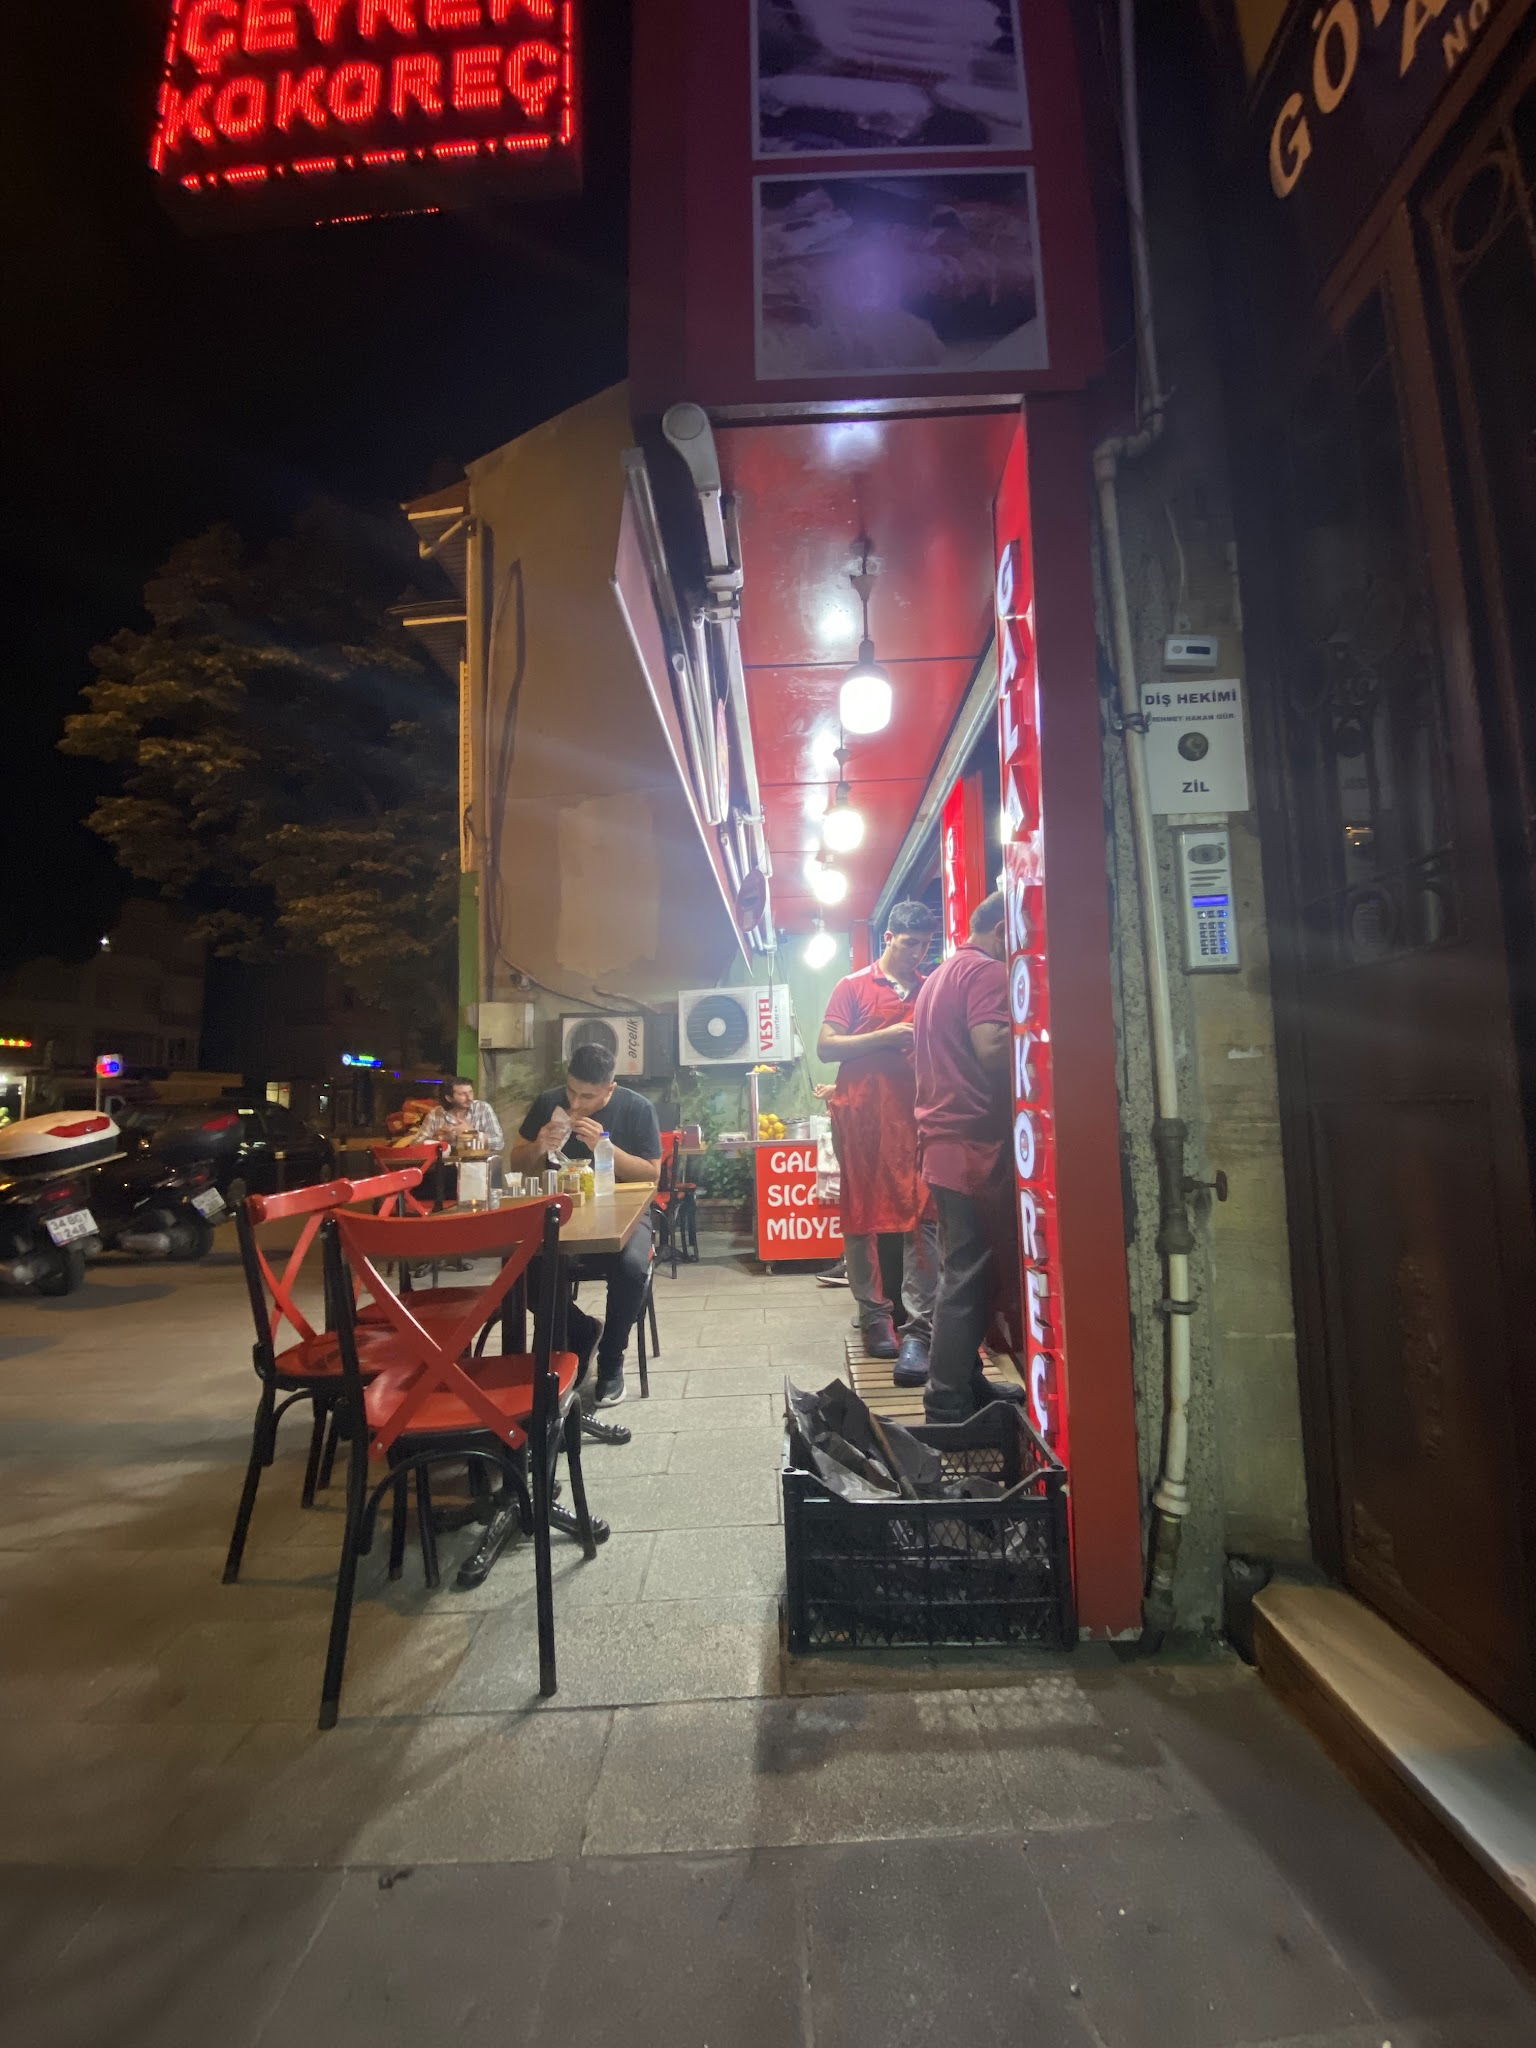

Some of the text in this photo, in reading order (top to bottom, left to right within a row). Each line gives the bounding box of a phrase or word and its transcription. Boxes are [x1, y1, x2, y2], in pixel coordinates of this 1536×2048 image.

[160, 40, 560, 149] KOKOREÇ
[1269, 0, 1392, 199] GÖ
[1145, 688, 1237, 707] DİŞ HEKİMİ
[1182, 779, 1210, 793] ZİL
[626, 1018, 640, 1059] arçelik
[770, 1151, 817, 1174] GAL
[1005, 870, 1053, 1439] KOKOREÇ
[767, 1183, 818, 1207] SICA
[51, 1219, 66, 1231] 34
[766, 1211, 844, 1241] MİDYE
